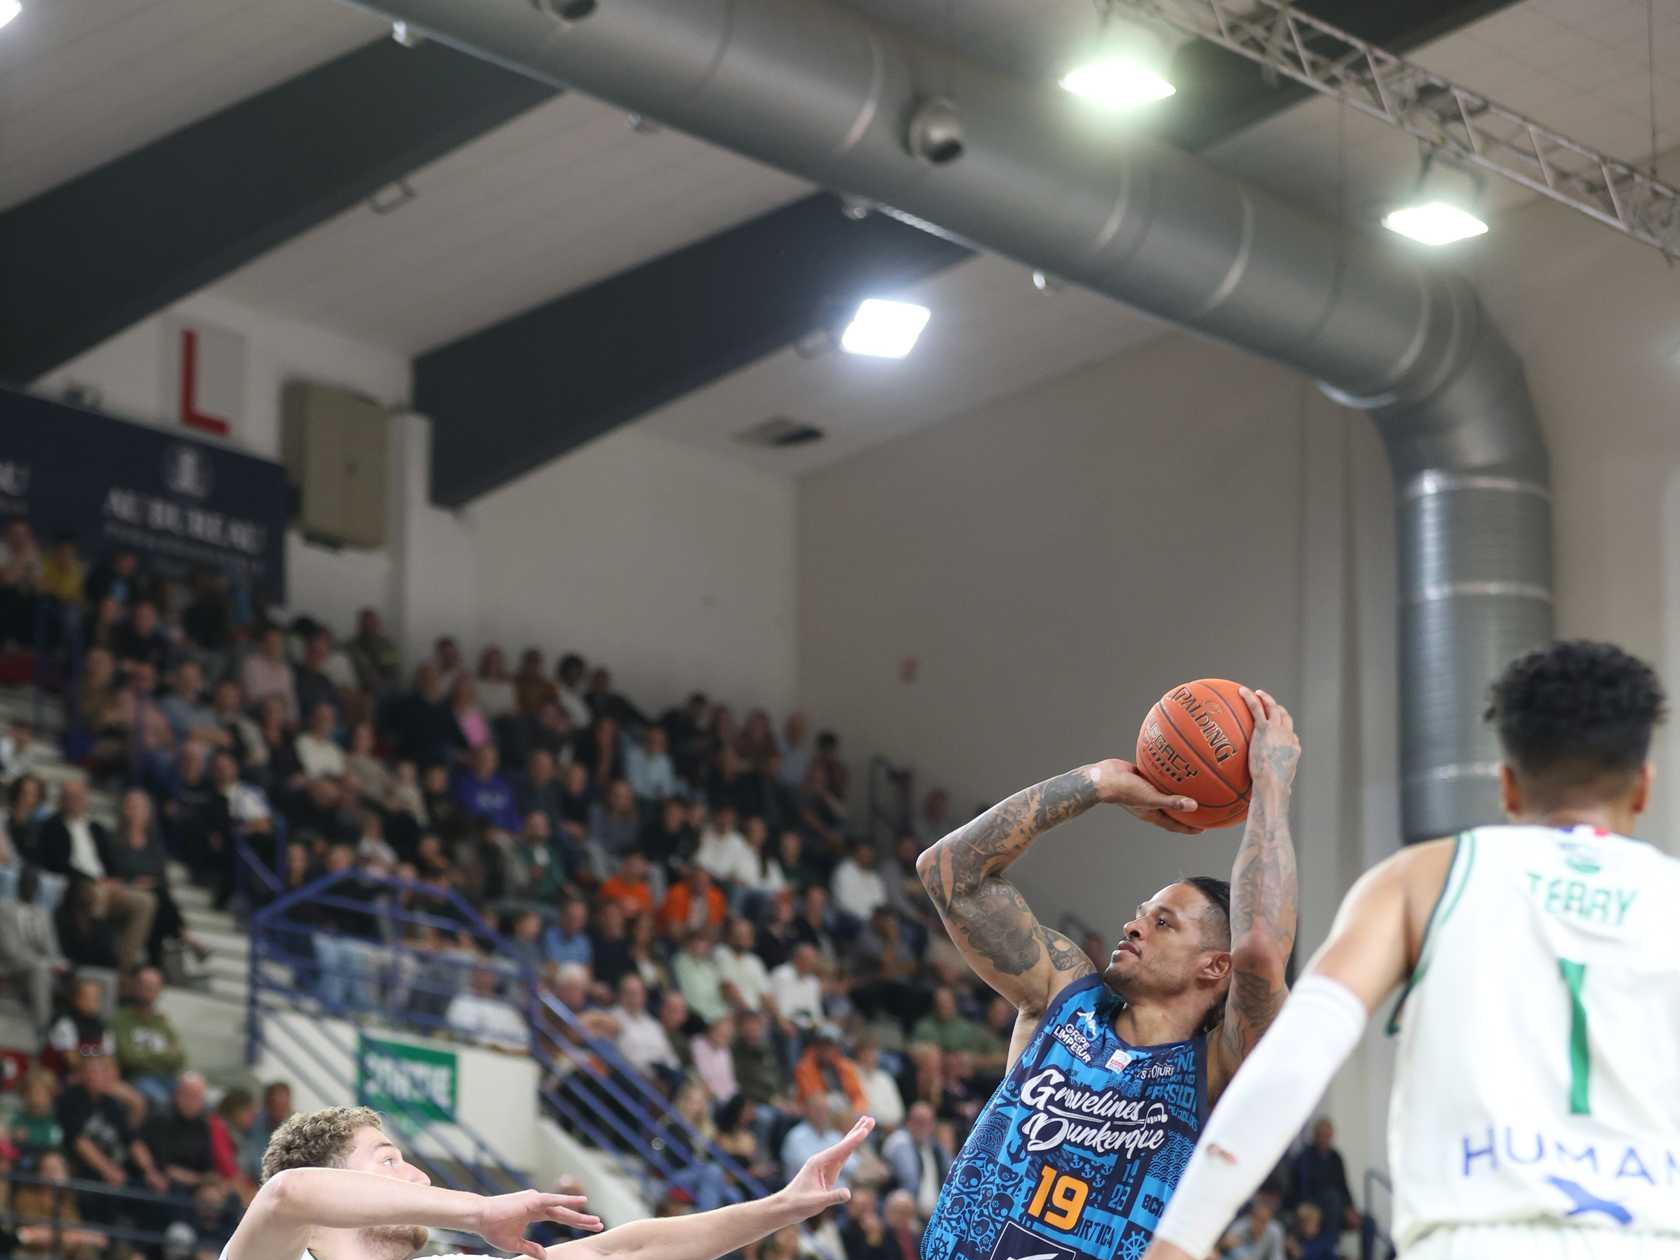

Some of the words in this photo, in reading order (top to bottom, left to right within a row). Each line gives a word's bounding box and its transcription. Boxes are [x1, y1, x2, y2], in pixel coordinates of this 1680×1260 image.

[181, 330, 230, 434] L
[1526, 870, 1638, 928] TERRY
[1558, 956, 1592, 1116] 1
[1020, 1069, 1144, 1121] Gravelines
[1022, 1114, 1167, 1160] Dunkerque
[1028, 1165, 1088, 1230] 19
